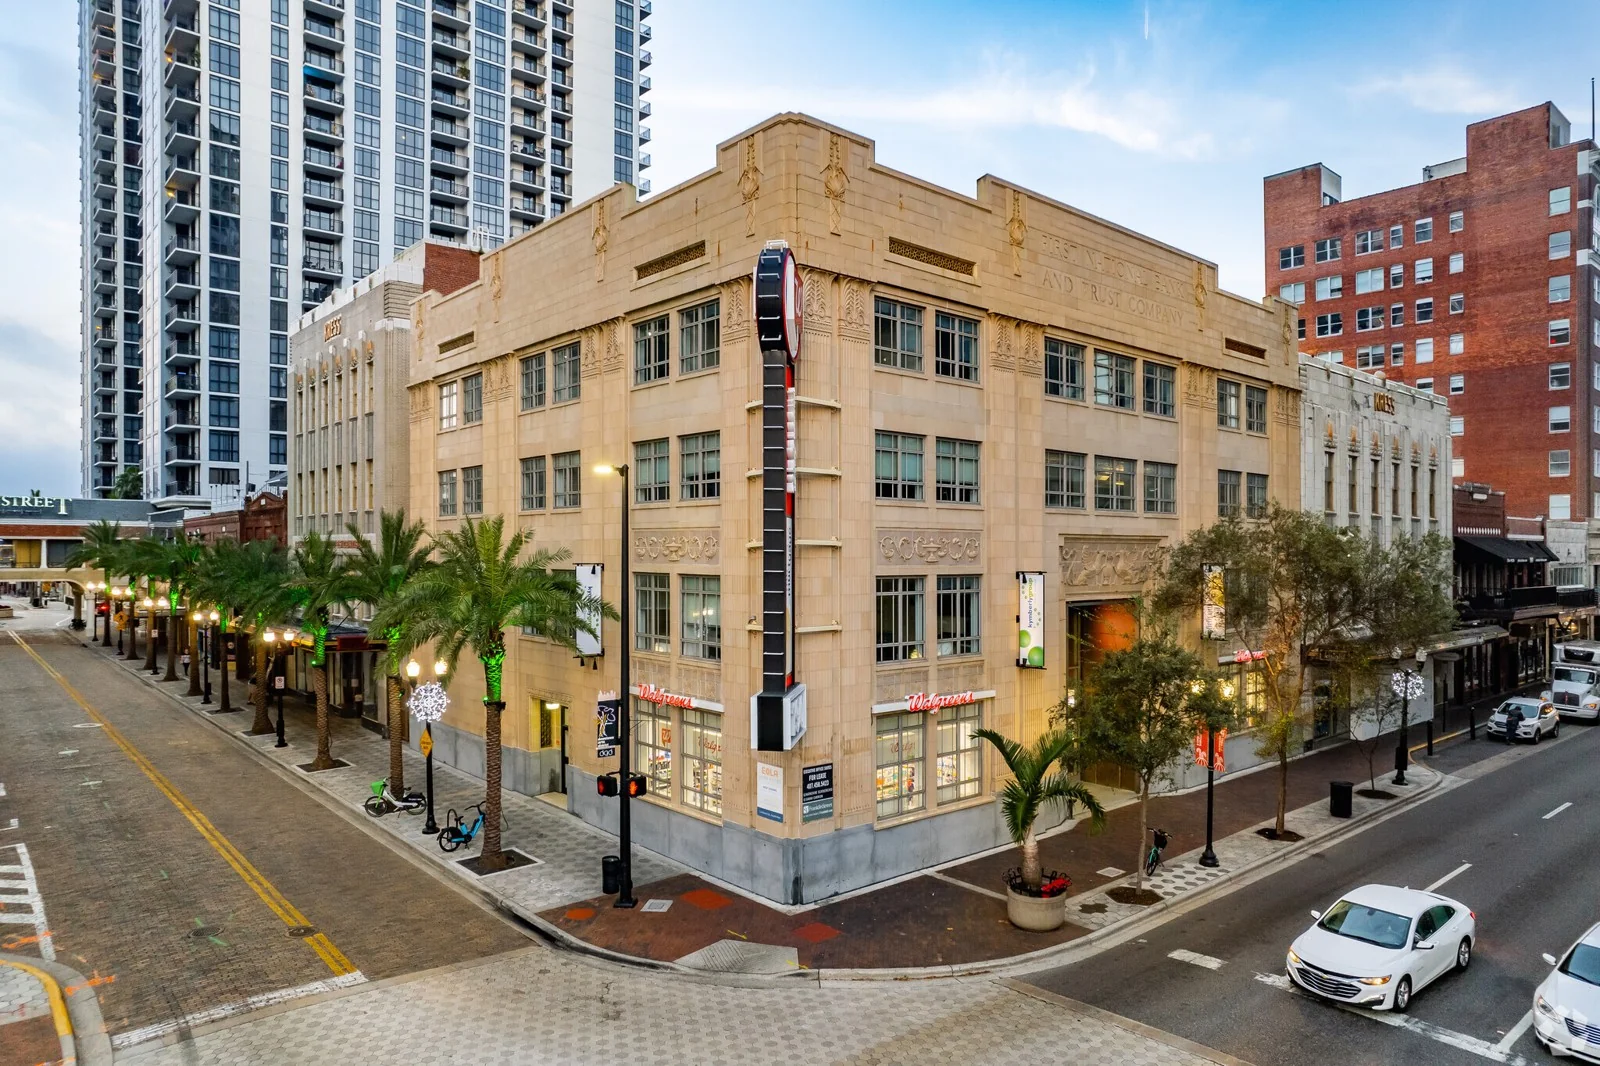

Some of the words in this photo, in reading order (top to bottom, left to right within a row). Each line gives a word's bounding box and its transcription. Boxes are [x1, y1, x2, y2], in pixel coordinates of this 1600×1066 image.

[1042, 234, 1078, 262] FIRST
[1086, 248, 1149, 287] NATIONAL
[1154, 273, 1185, 299] BANK
[1042, 269, 1074, 294] AND
[1082, 280, 1121, 308] TRUST
[1128, 296, 1185, 326] COMPANY
[1374, 392, 1395, 415] KRESS
[1, 495, 73, 515] STREET
[638, 683, 694, 709] Walgreens
[907, 692, 976, 714] Walgreens
[816, 772, 827, 780] LEASE
